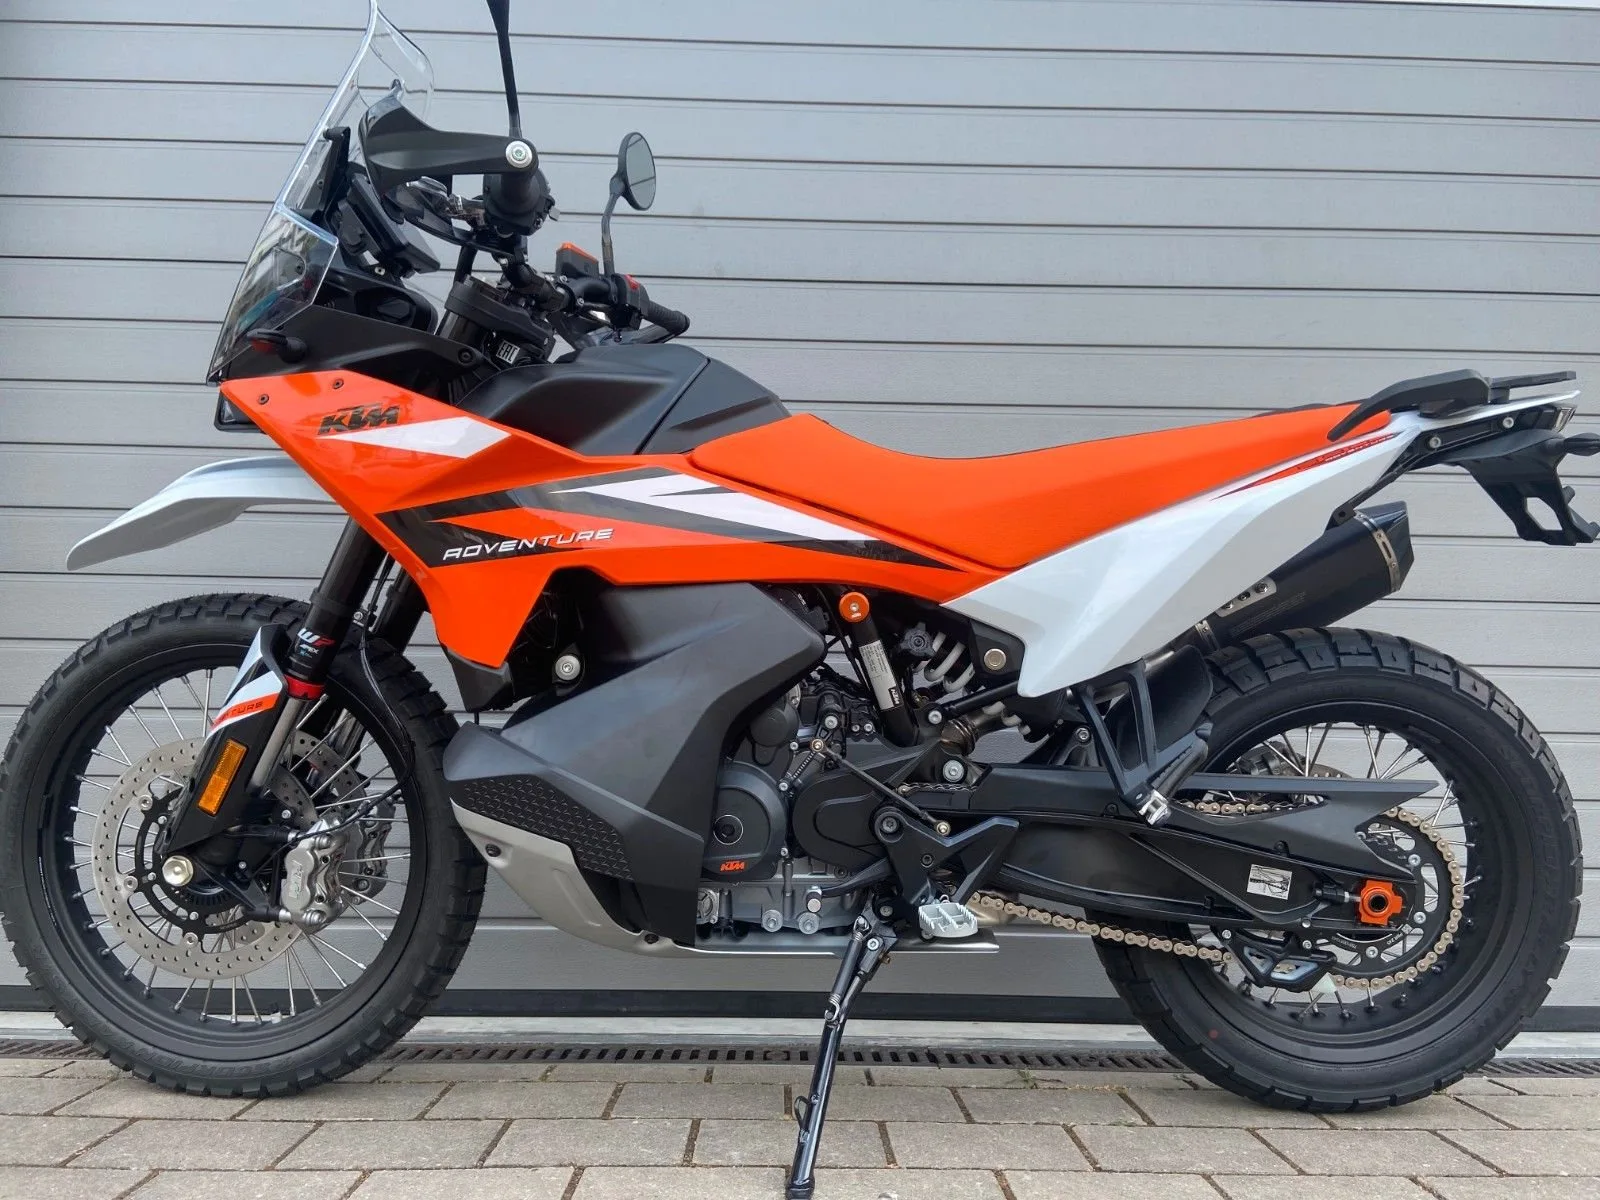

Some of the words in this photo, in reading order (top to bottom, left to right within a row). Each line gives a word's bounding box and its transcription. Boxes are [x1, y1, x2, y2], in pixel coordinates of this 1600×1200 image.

[317, 403, 399, 436] KTM
[442, 528, 613, 561] ADVENTURE
[297, 627, 335, 647] WP
[720, 860, 745, 871] KTM
